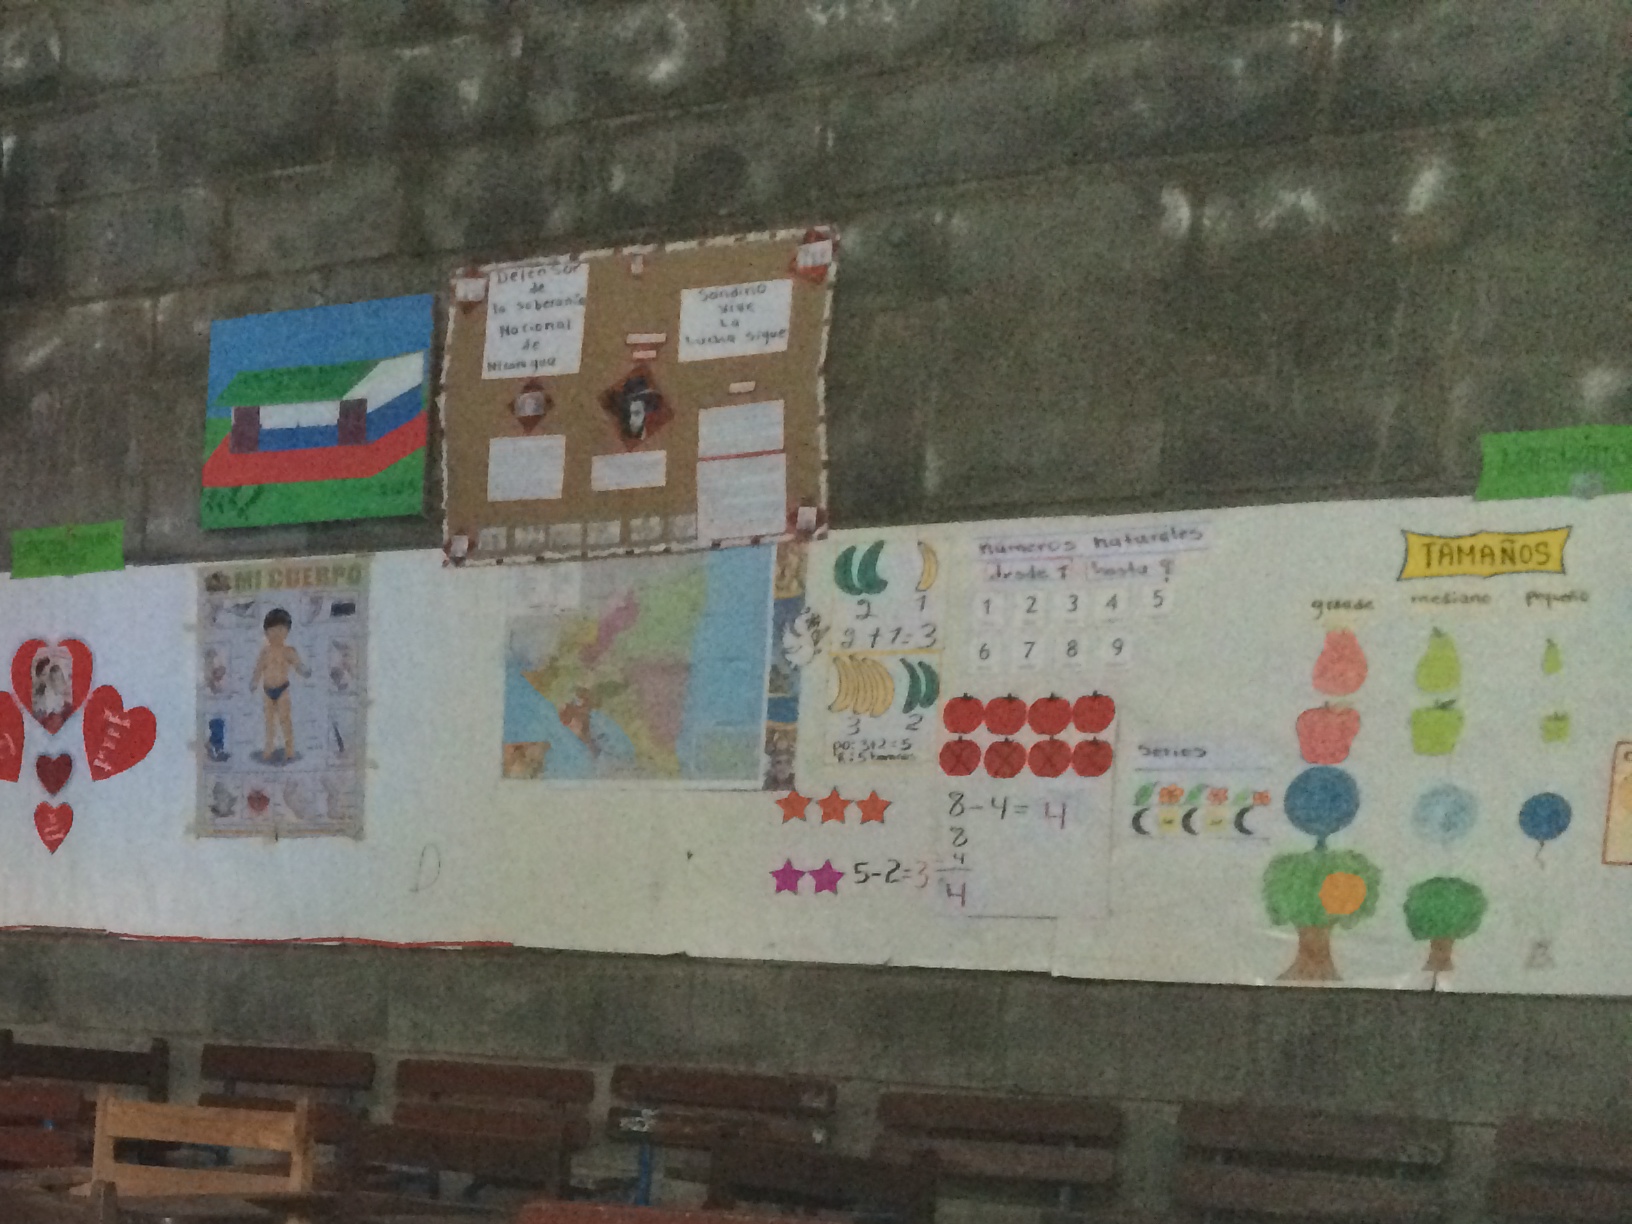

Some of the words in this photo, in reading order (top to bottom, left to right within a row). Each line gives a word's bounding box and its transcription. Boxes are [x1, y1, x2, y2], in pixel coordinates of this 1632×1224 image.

[699, 284, 767, 301] Sandino
[1421, 539, 1551, 569] TAMAÑOS
[234, 570, 263, 591] MI
[267, 567, 363, 591] CUERPO
[855, 599, 878, 620] 2
[916, 595, 926, 611] 1
[983, 598, 991, 615] 1
[1025, 595, 1038, 614] 2
[1068, 593, 1079, 612] 3
[1105, 593, 1118, 610] 4
[1152, 589, 1164, 609] 5
[979, 643, 991, 661] 6
[1023, 641, 1036, 659] 7
[1066, 639, 1078, 658] 8
[1111, 637, 1124, 656] 9
[847, 716, 861, 736] 3
[905, 713, 924, 731] 2
[946, 882, 966, 907] 4
